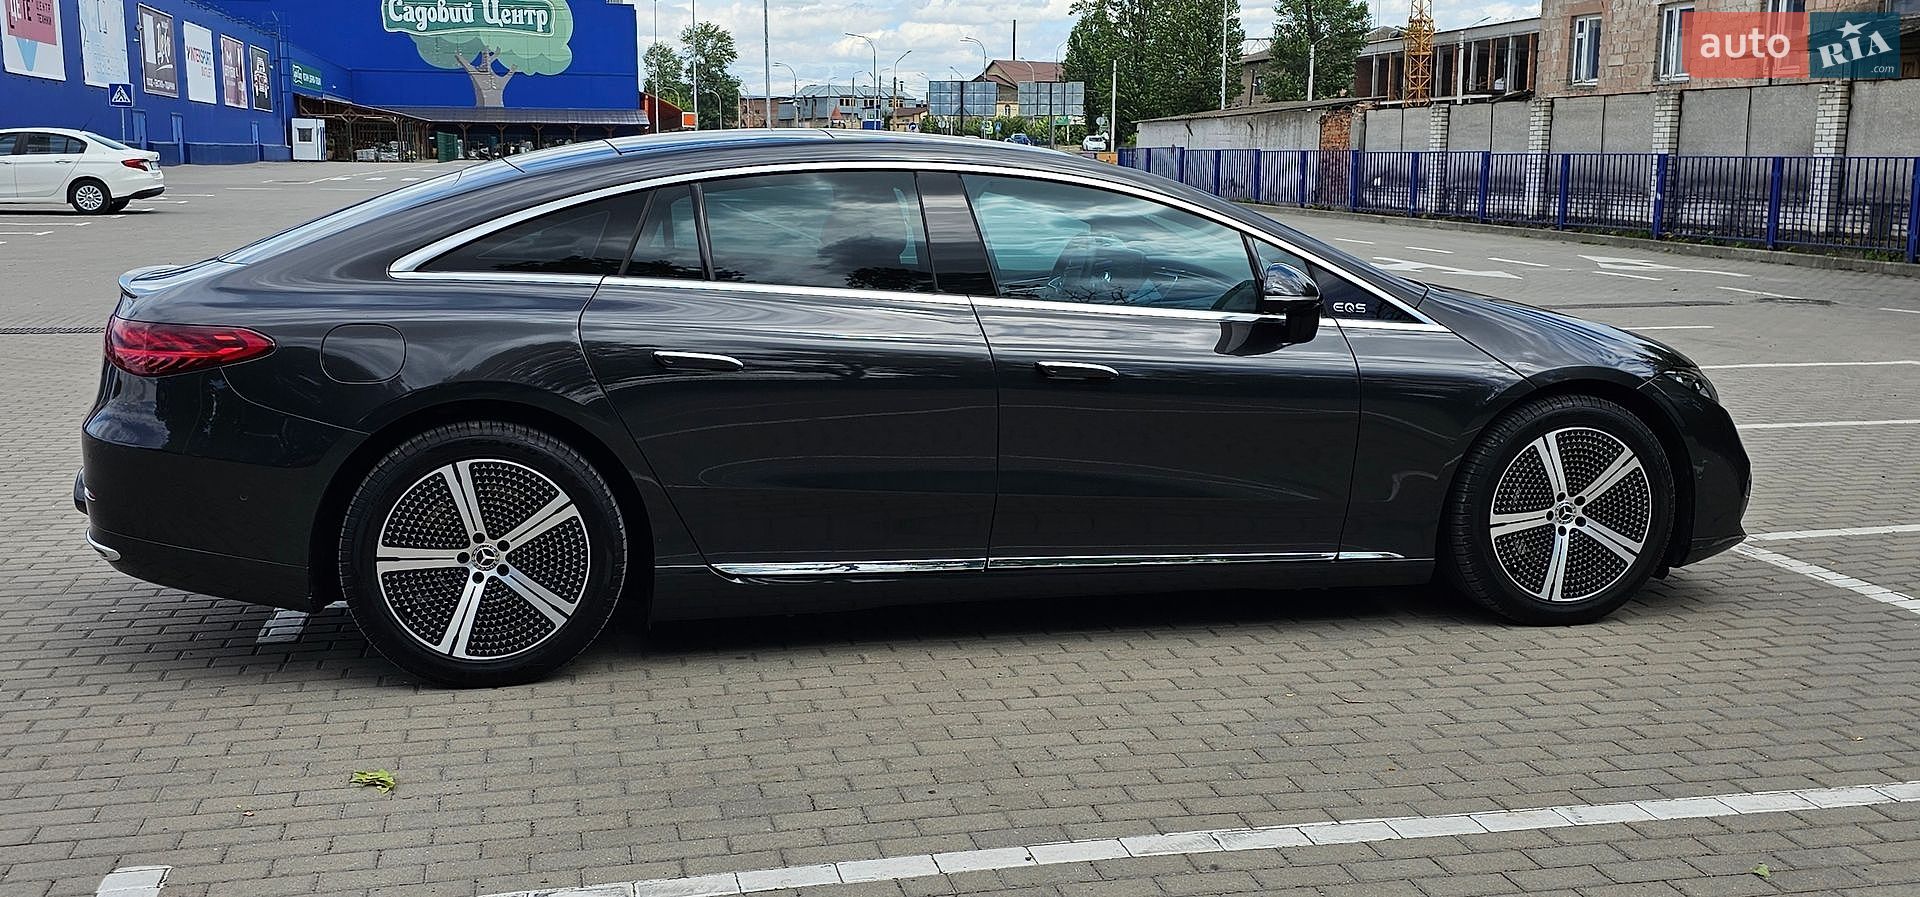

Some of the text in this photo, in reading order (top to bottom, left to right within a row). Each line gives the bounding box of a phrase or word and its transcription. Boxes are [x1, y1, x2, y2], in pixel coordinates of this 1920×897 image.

[388, 0, 549, 32] Садовий Центр
[1333, 302, 1366, 313] EQS
